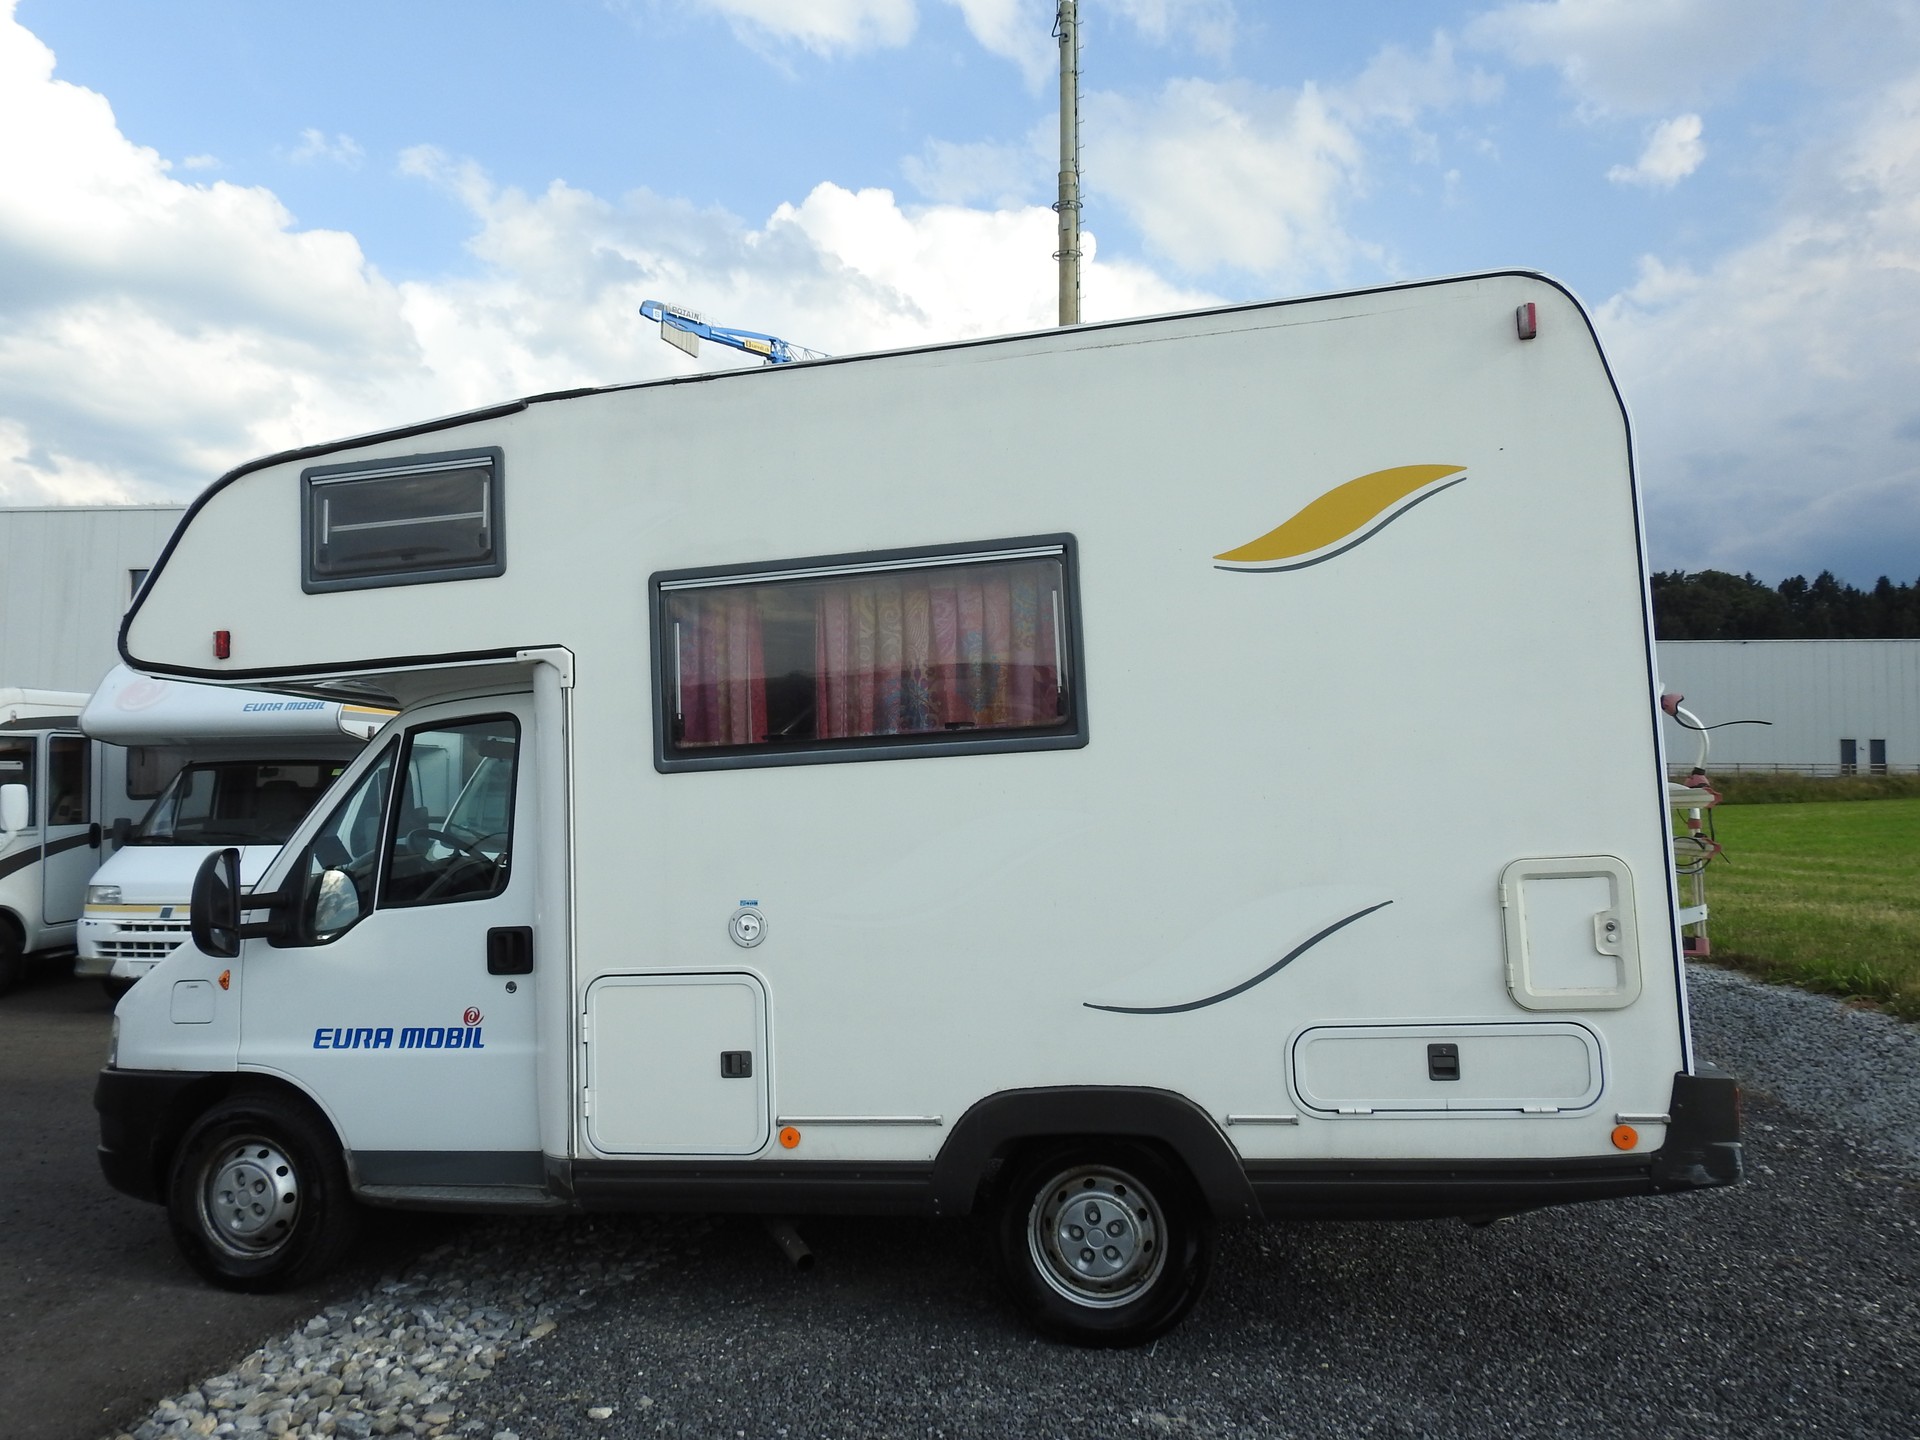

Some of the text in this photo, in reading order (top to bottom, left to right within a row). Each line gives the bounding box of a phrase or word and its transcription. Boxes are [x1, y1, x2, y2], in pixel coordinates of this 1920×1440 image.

[242, 701, 325, 712] EURA MOBIL
[313, 1026, 485, 1049] EURA MOBIL
